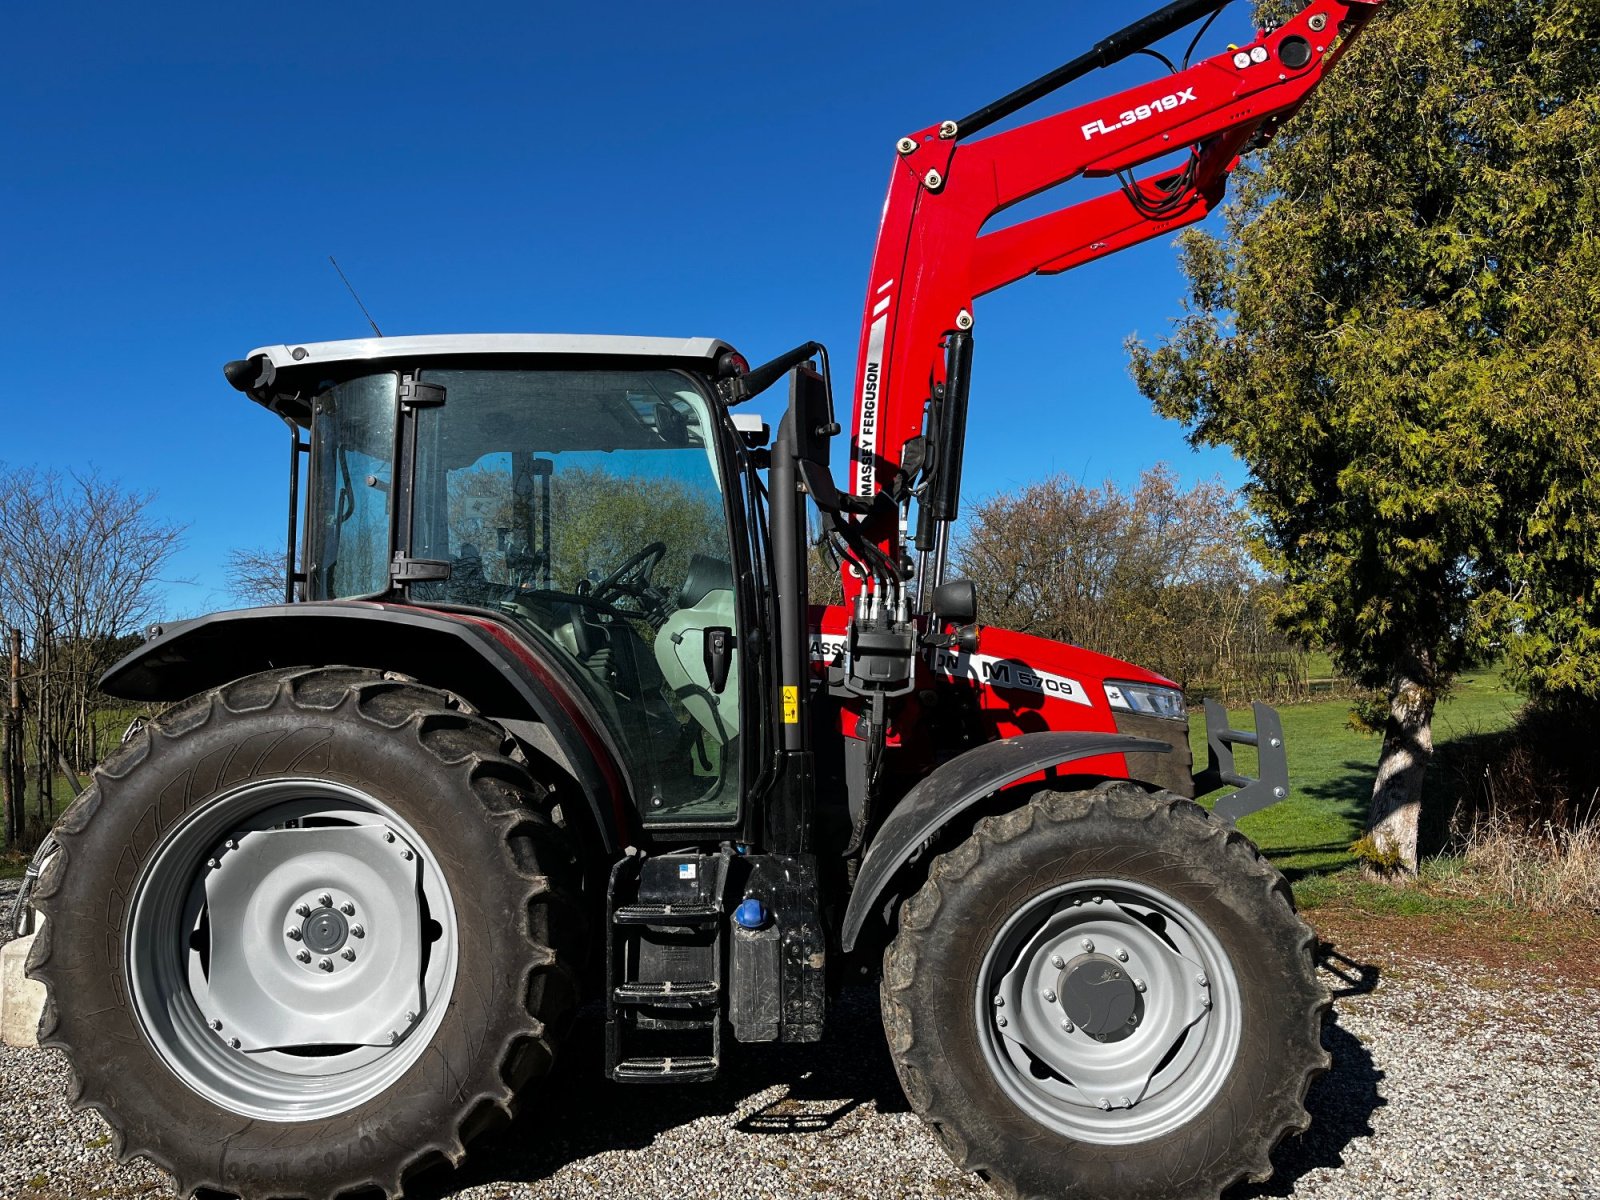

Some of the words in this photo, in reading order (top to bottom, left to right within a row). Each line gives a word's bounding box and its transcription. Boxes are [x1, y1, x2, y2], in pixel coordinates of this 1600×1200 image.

[1081, 87, 1197, 140] FL.3919X
[863, 363, 879, 434] FERGUSON
[862, 440, 875, 496] MASSEY
[982, 661, 1010, 683] M
[1017, 671, 1072, 695] 5709
